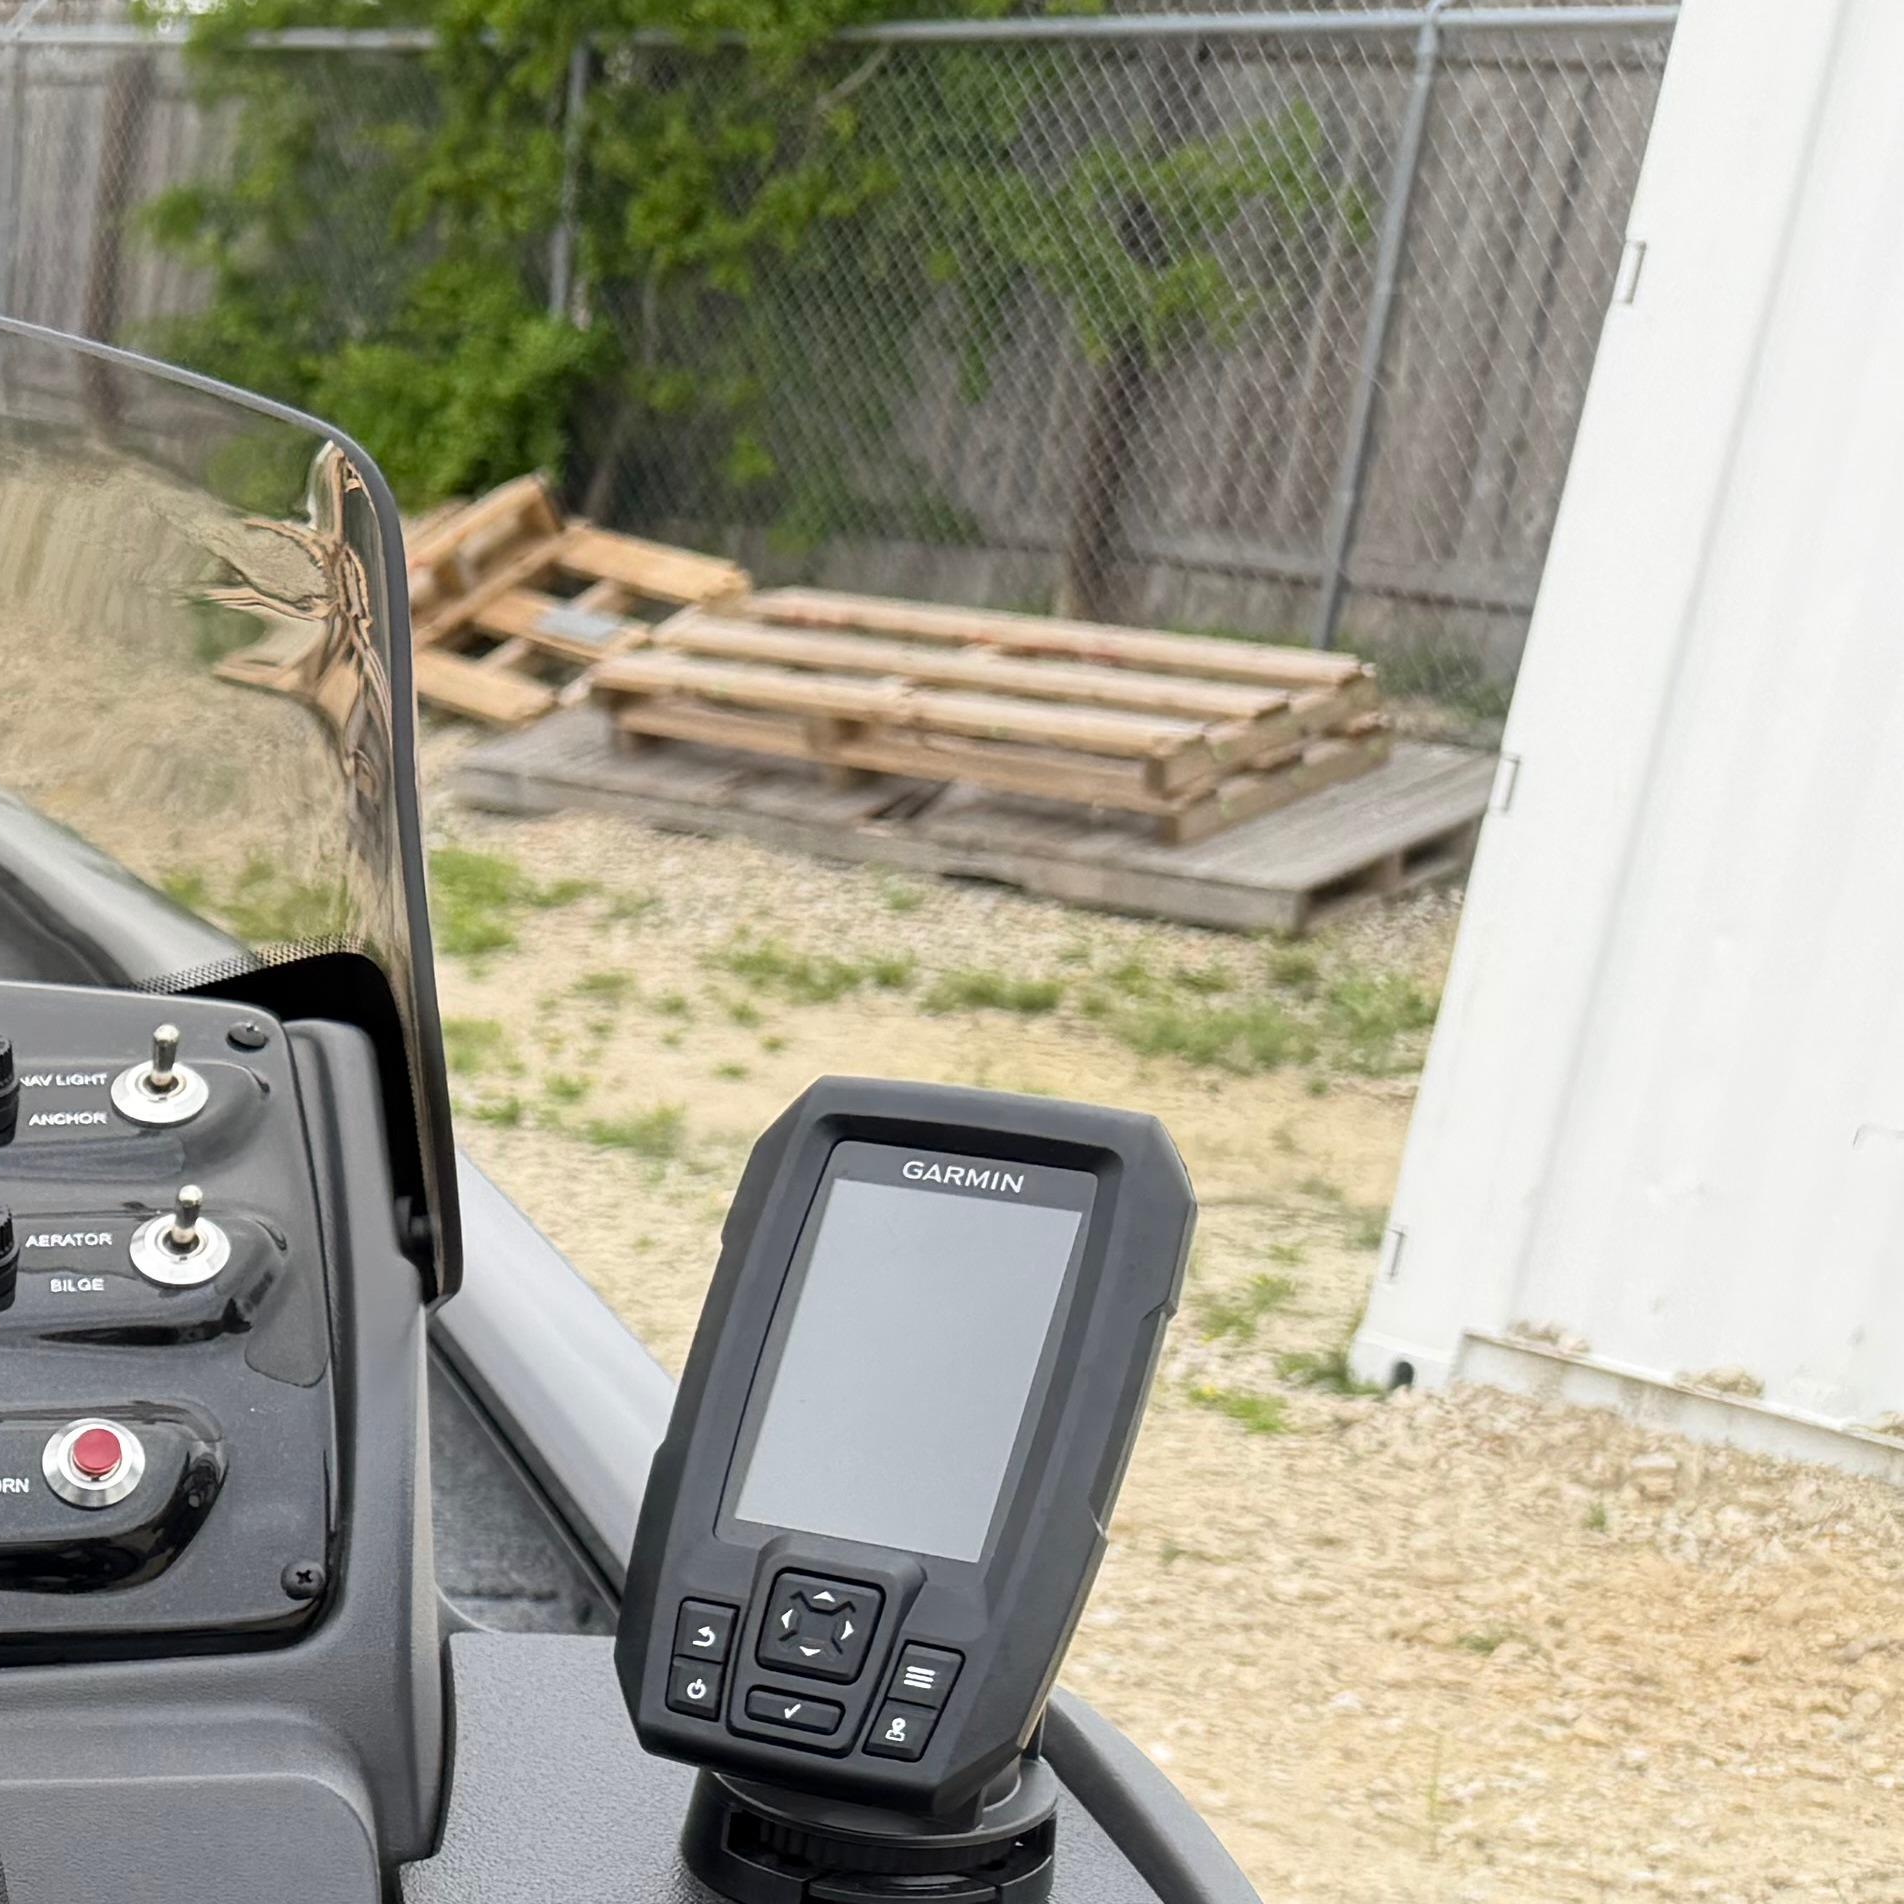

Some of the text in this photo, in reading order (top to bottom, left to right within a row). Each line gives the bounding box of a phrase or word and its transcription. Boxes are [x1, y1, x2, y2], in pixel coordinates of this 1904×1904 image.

[56, 1072, 108, 1086] LIGHT
[28, 1112, 107, 1126] ANCHOR
[902, 1161, 1024, 1193] GARMIN
[25, 1233, 113, 1248] AERATOR
[50, 1278, 105, 1293] BILGE
